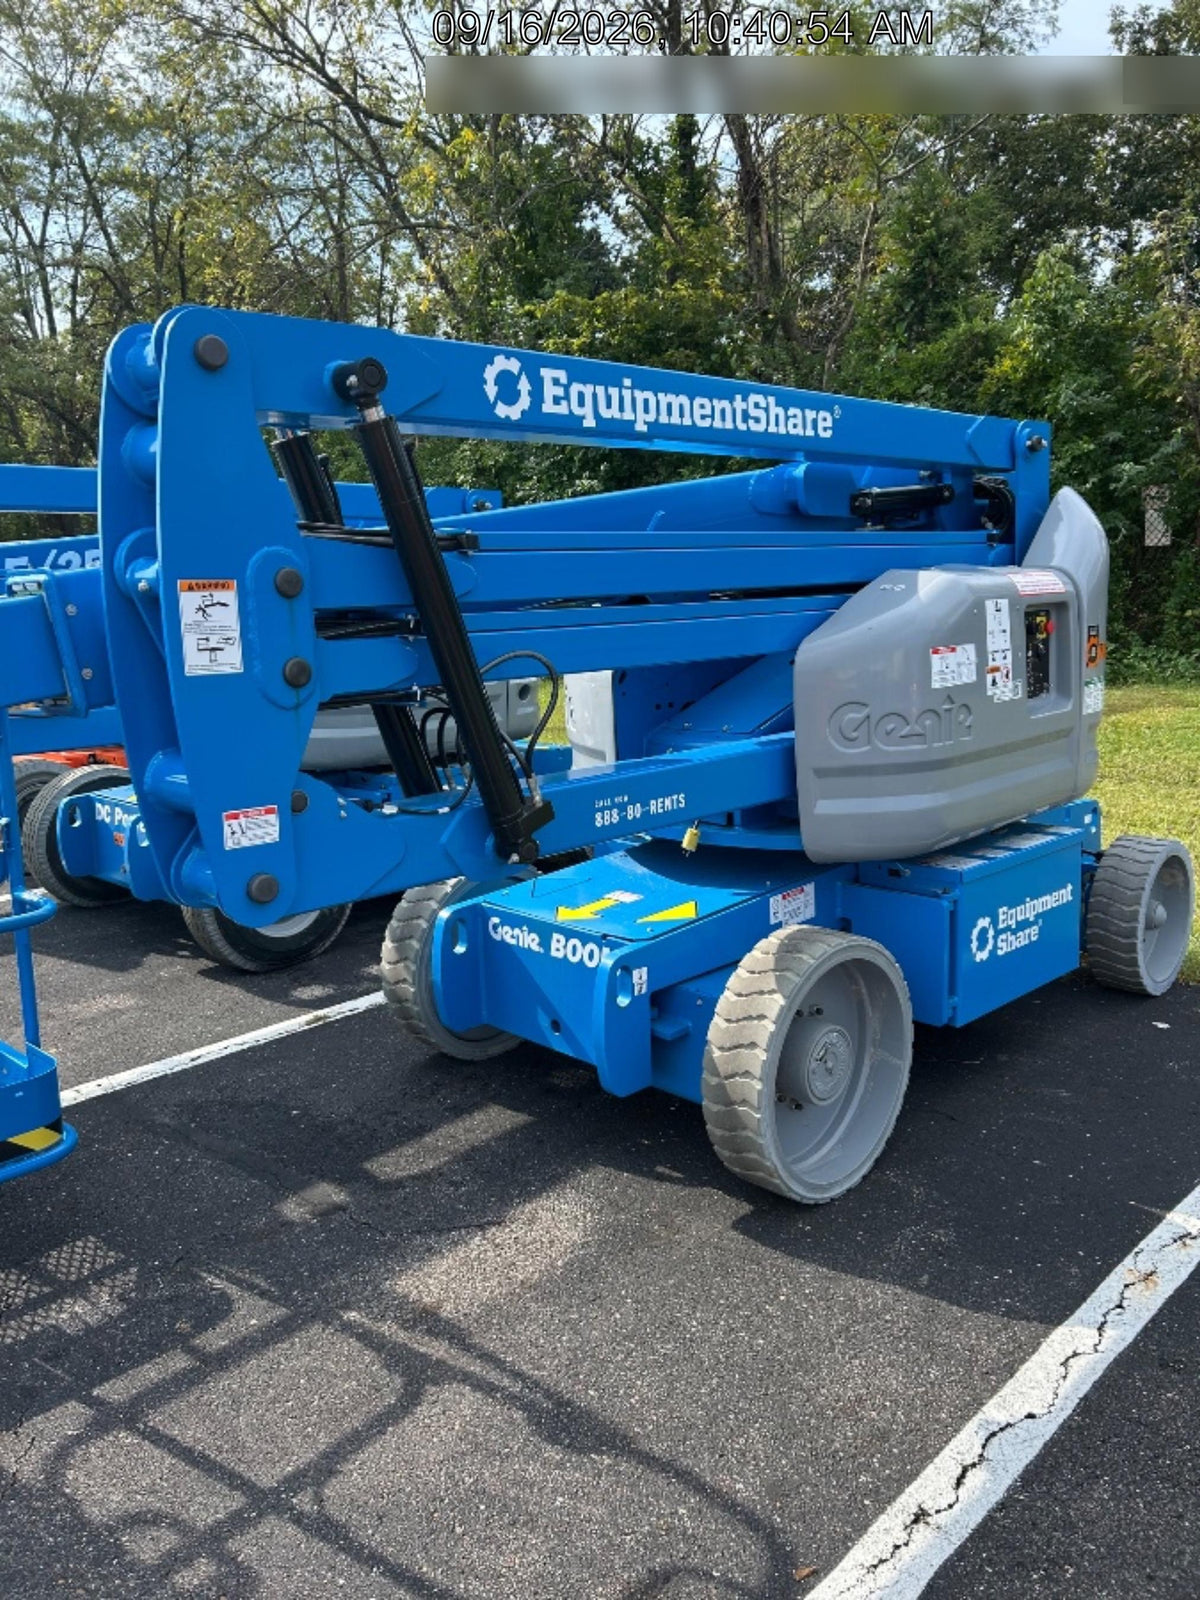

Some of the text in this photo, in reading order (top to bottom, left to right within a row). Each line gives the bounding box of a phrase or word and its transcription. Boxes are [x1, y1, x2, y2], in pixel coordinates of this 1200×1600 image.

[827, 694, 973, 753] Genie
[95, 802, 111, 824] DC
[997, 882, 1073, 929] Equipment
[551, 932, 613, 968] BOO
